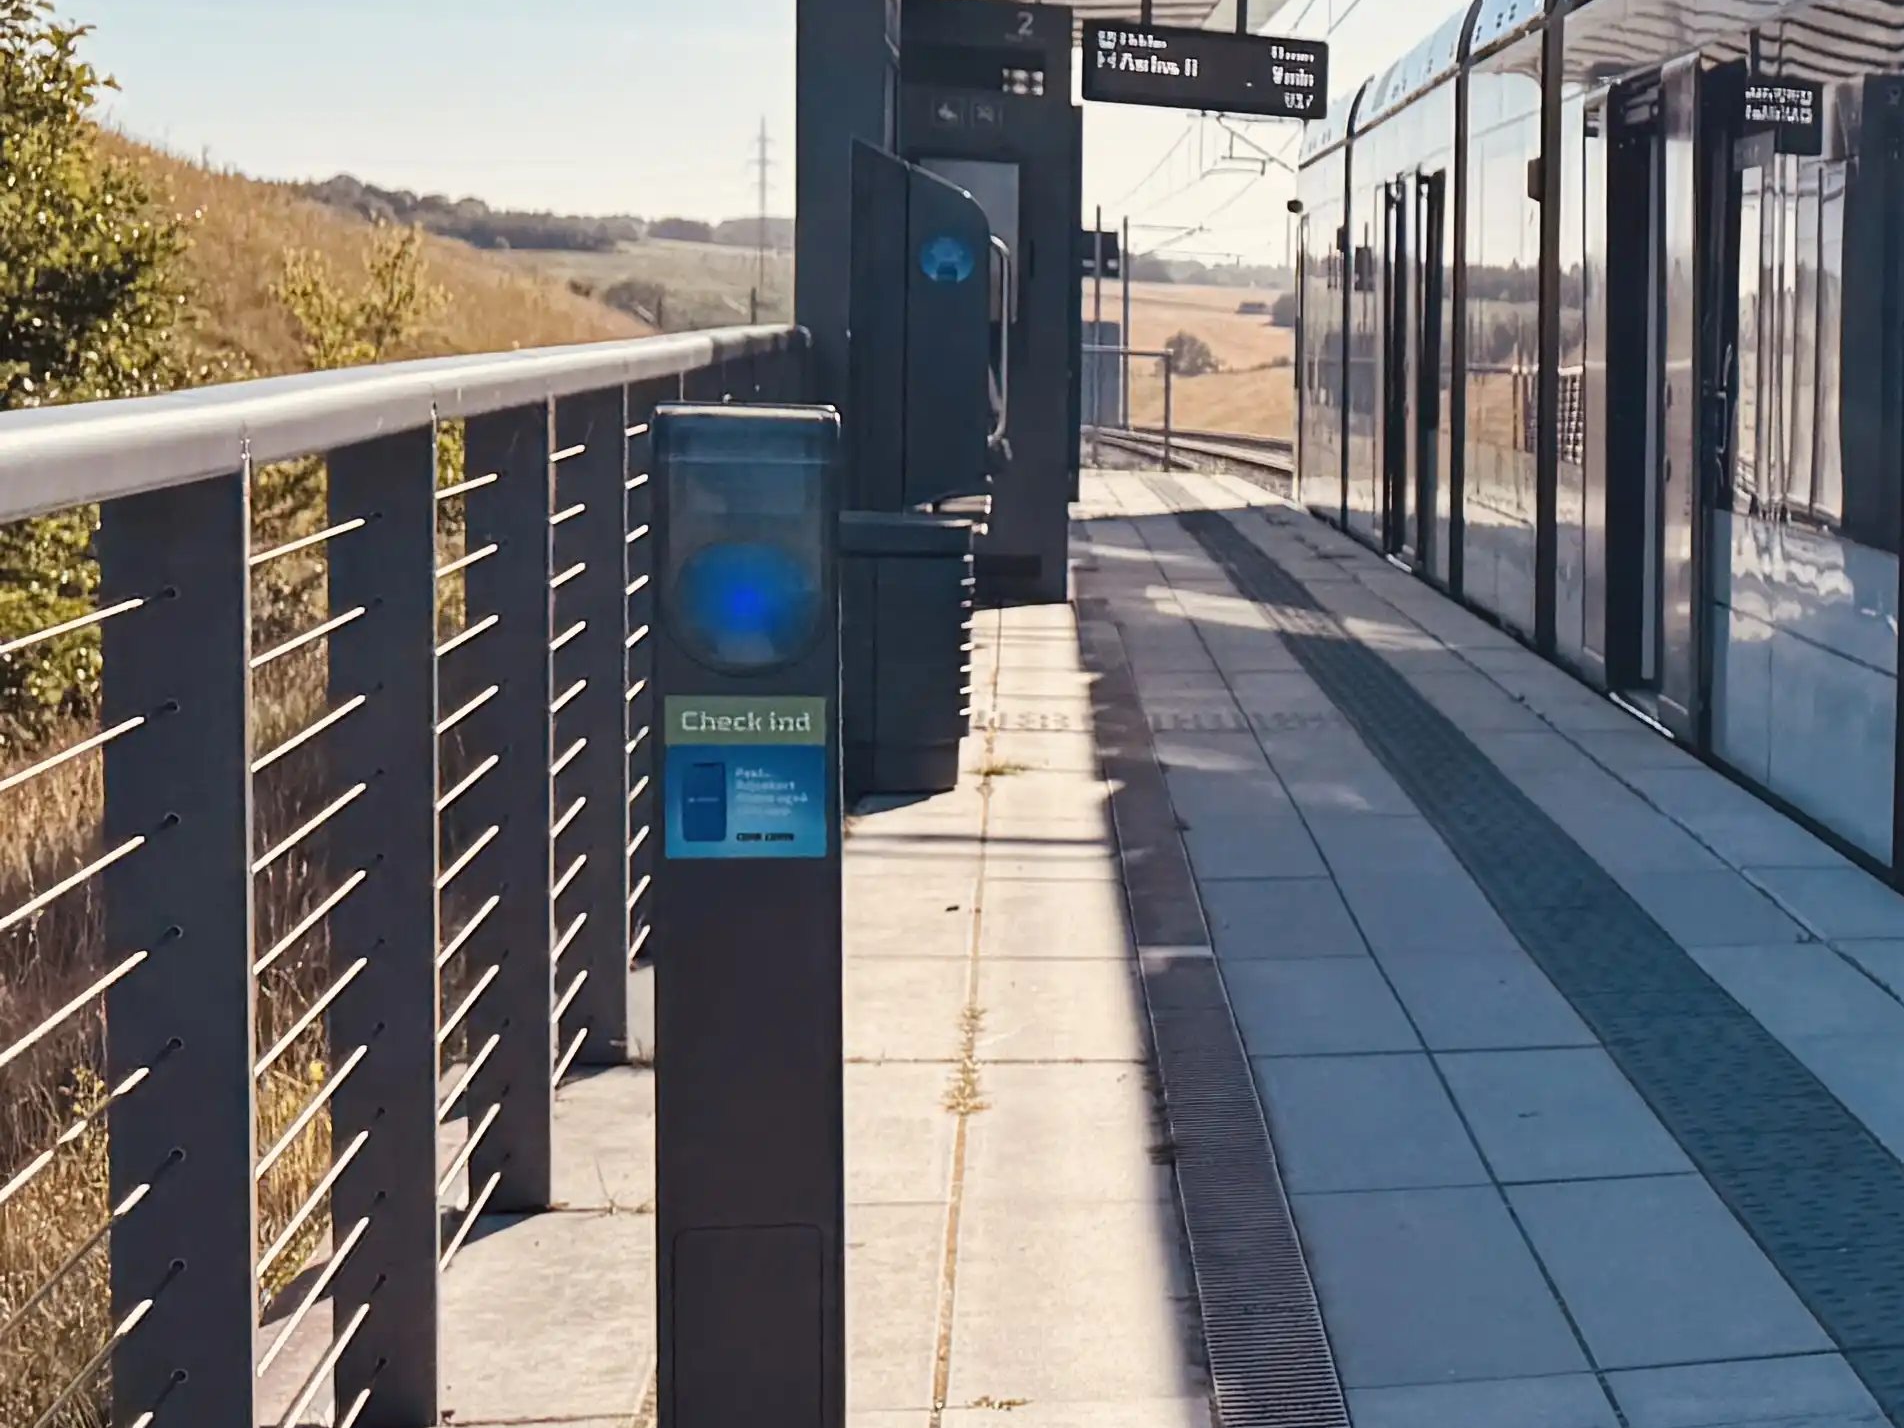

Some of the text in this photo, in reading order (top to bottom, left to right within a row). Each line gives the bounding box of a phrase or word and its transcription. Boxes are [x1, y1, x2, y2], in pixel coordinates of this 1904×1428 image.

[1017, 11, 1034, 36] 2
[681, 710, 812, 732] Check ind
